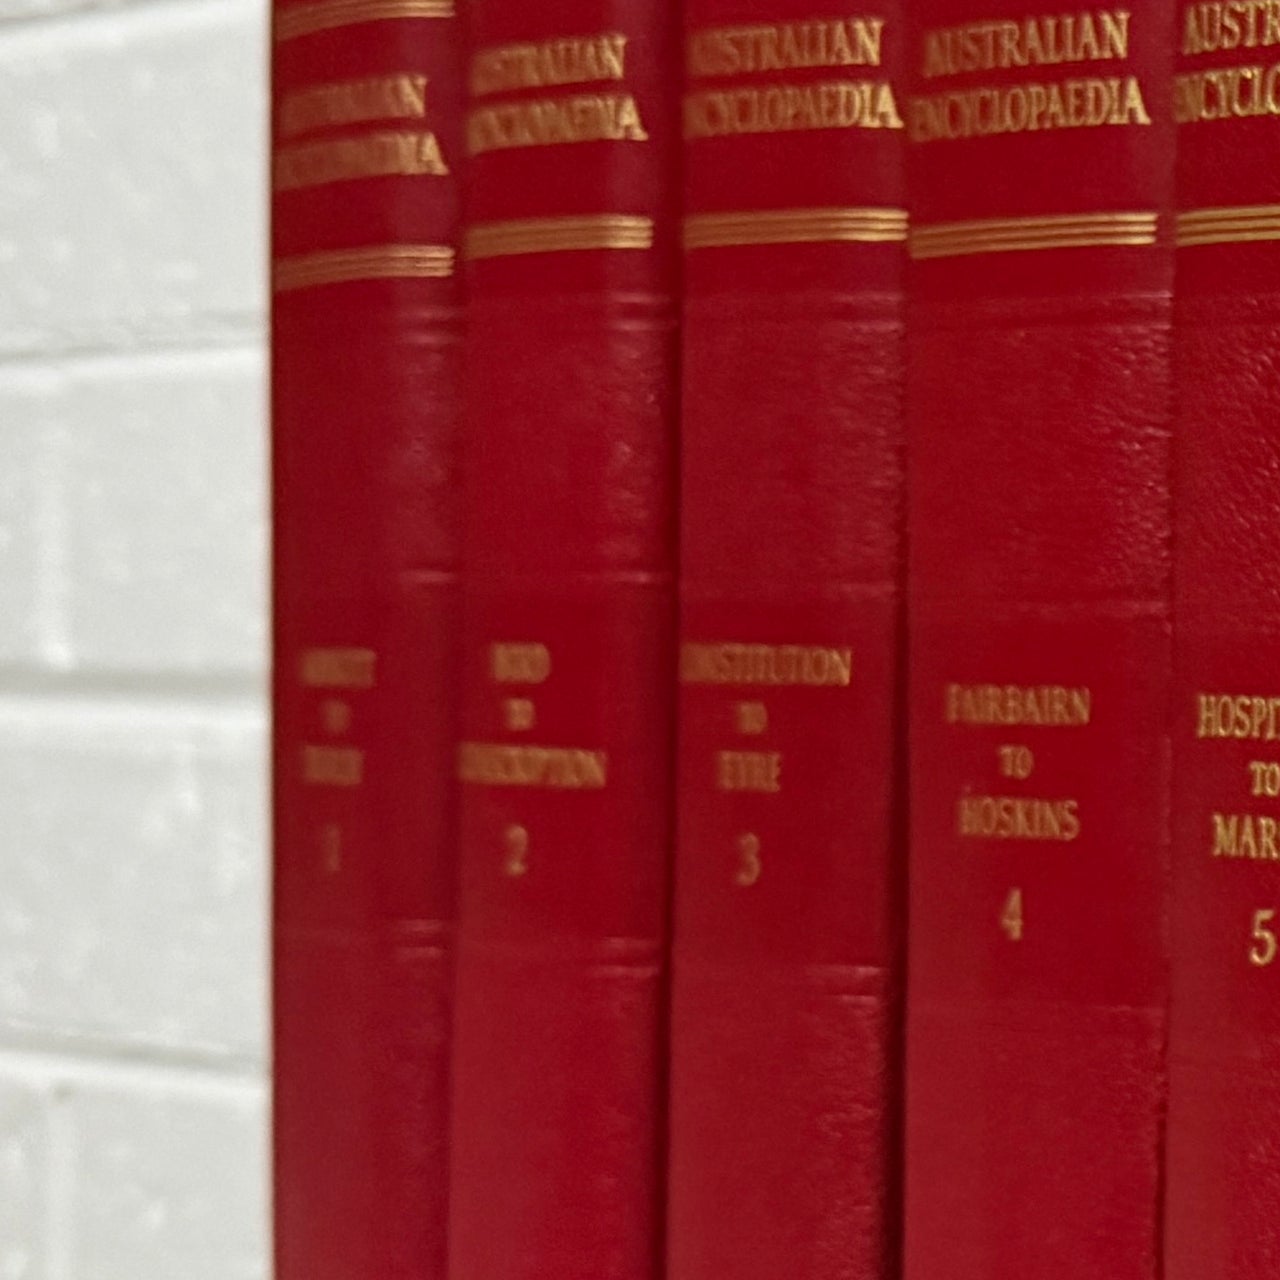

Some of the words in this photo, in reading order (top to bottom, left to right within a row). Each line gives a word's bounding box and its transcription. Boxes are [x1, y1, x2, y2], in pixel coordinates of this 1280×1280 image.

[688, 17, 885, 78] STRALIAN
[922, 10, 1131, 77] AUSTRALIAN
[684, 80, 905, 139] CYCLOPAEDIA
[679, 641, 854, 688] STITUTION
[997, 744, 1035, 780] TO
[733, 831, 763, 888] 3
[999, 888, 1025, 942] 4
[1247, 908, 1279, 969] 5
